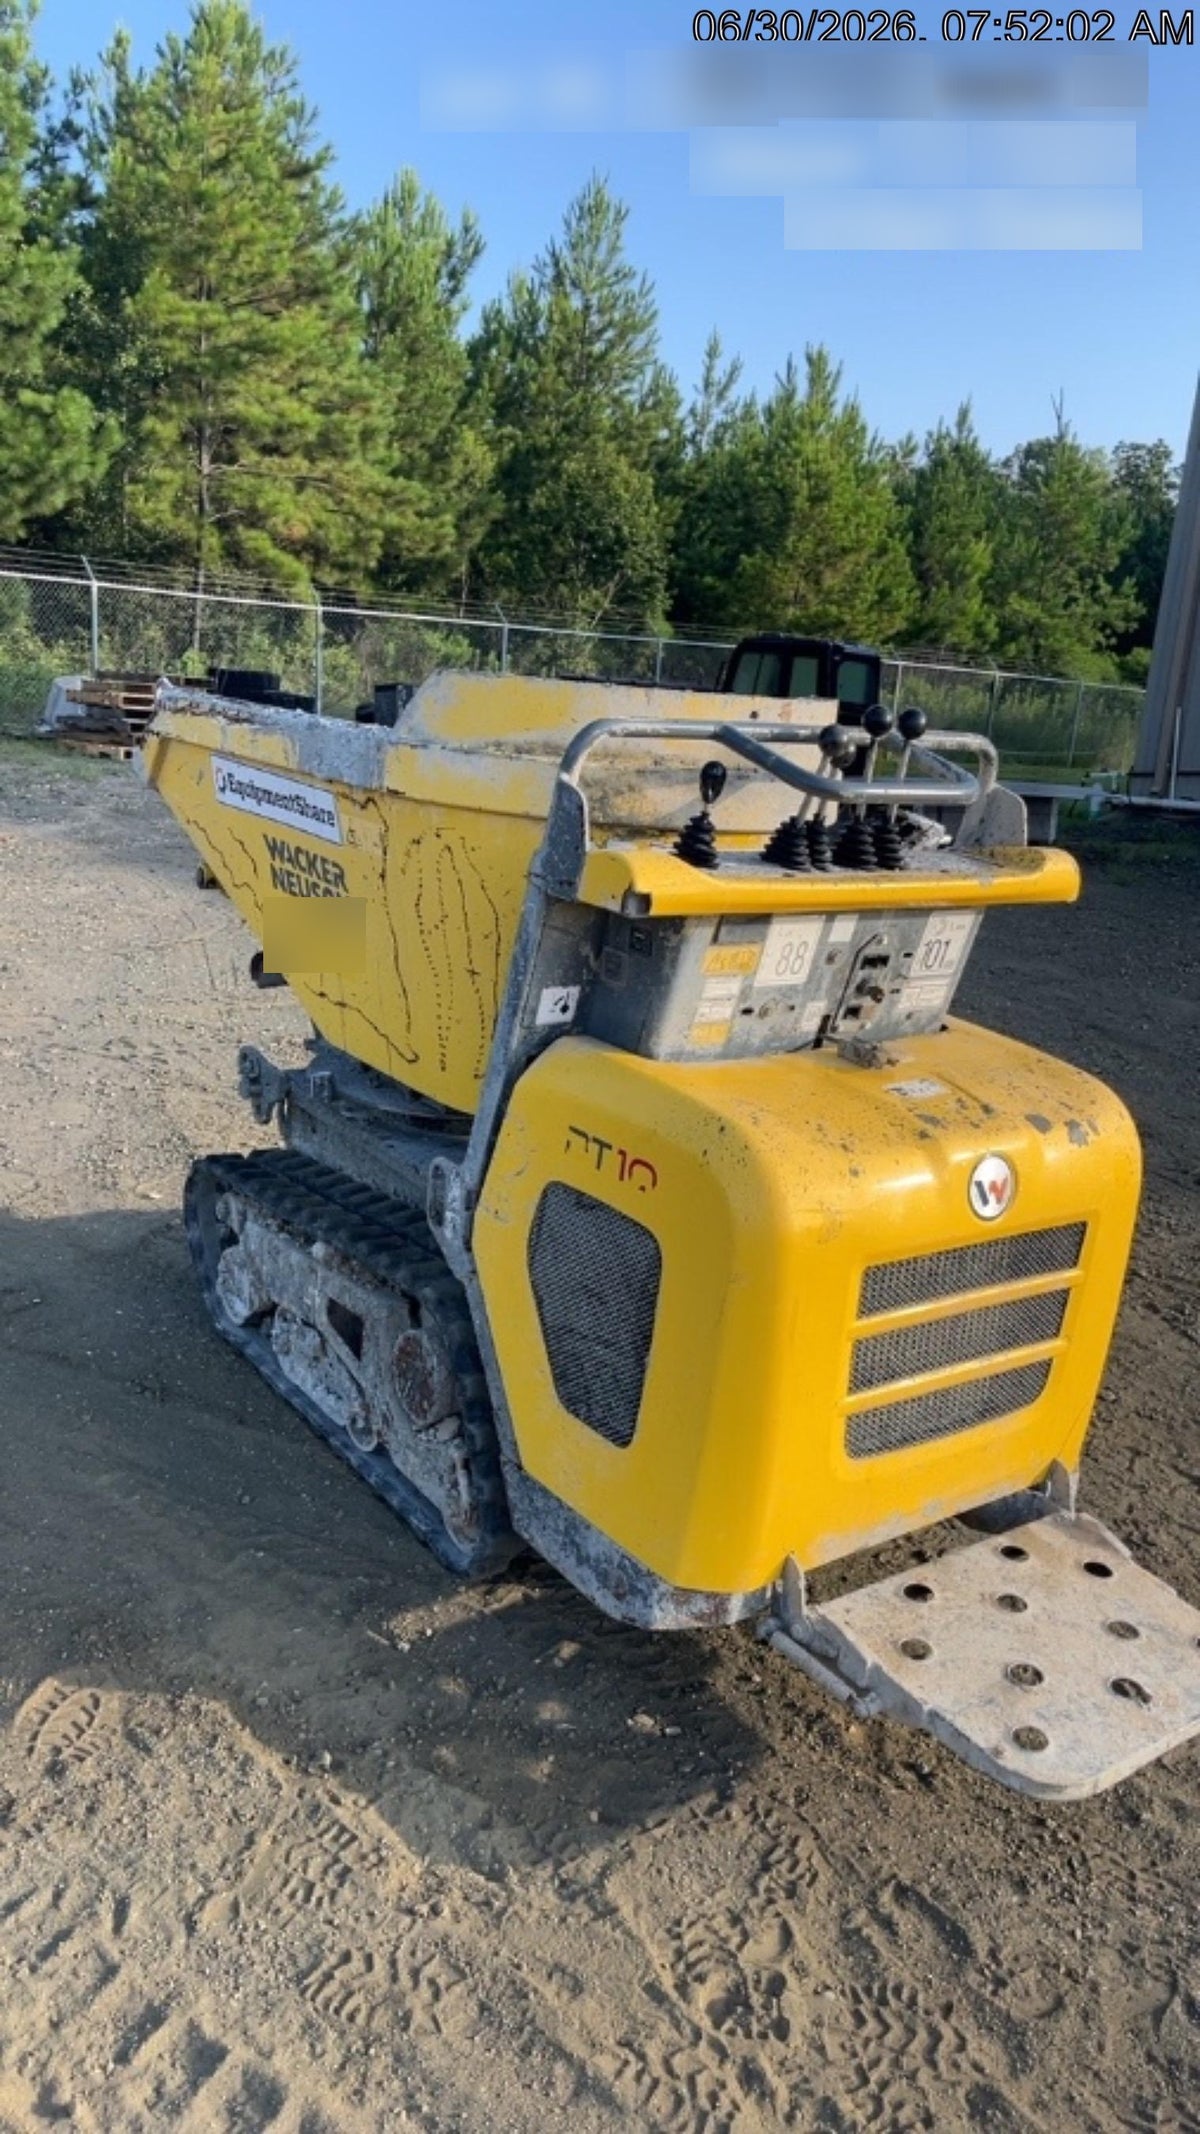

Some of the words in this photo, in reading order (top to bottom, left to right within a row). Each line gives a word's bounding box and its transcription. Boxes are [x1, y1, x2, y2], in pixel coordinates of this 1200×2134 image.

[226, 772, 336, 828] EquipmentShare
[262, 833, 350, 894] WACKER
[269, 862, 347, 897] NEUS
